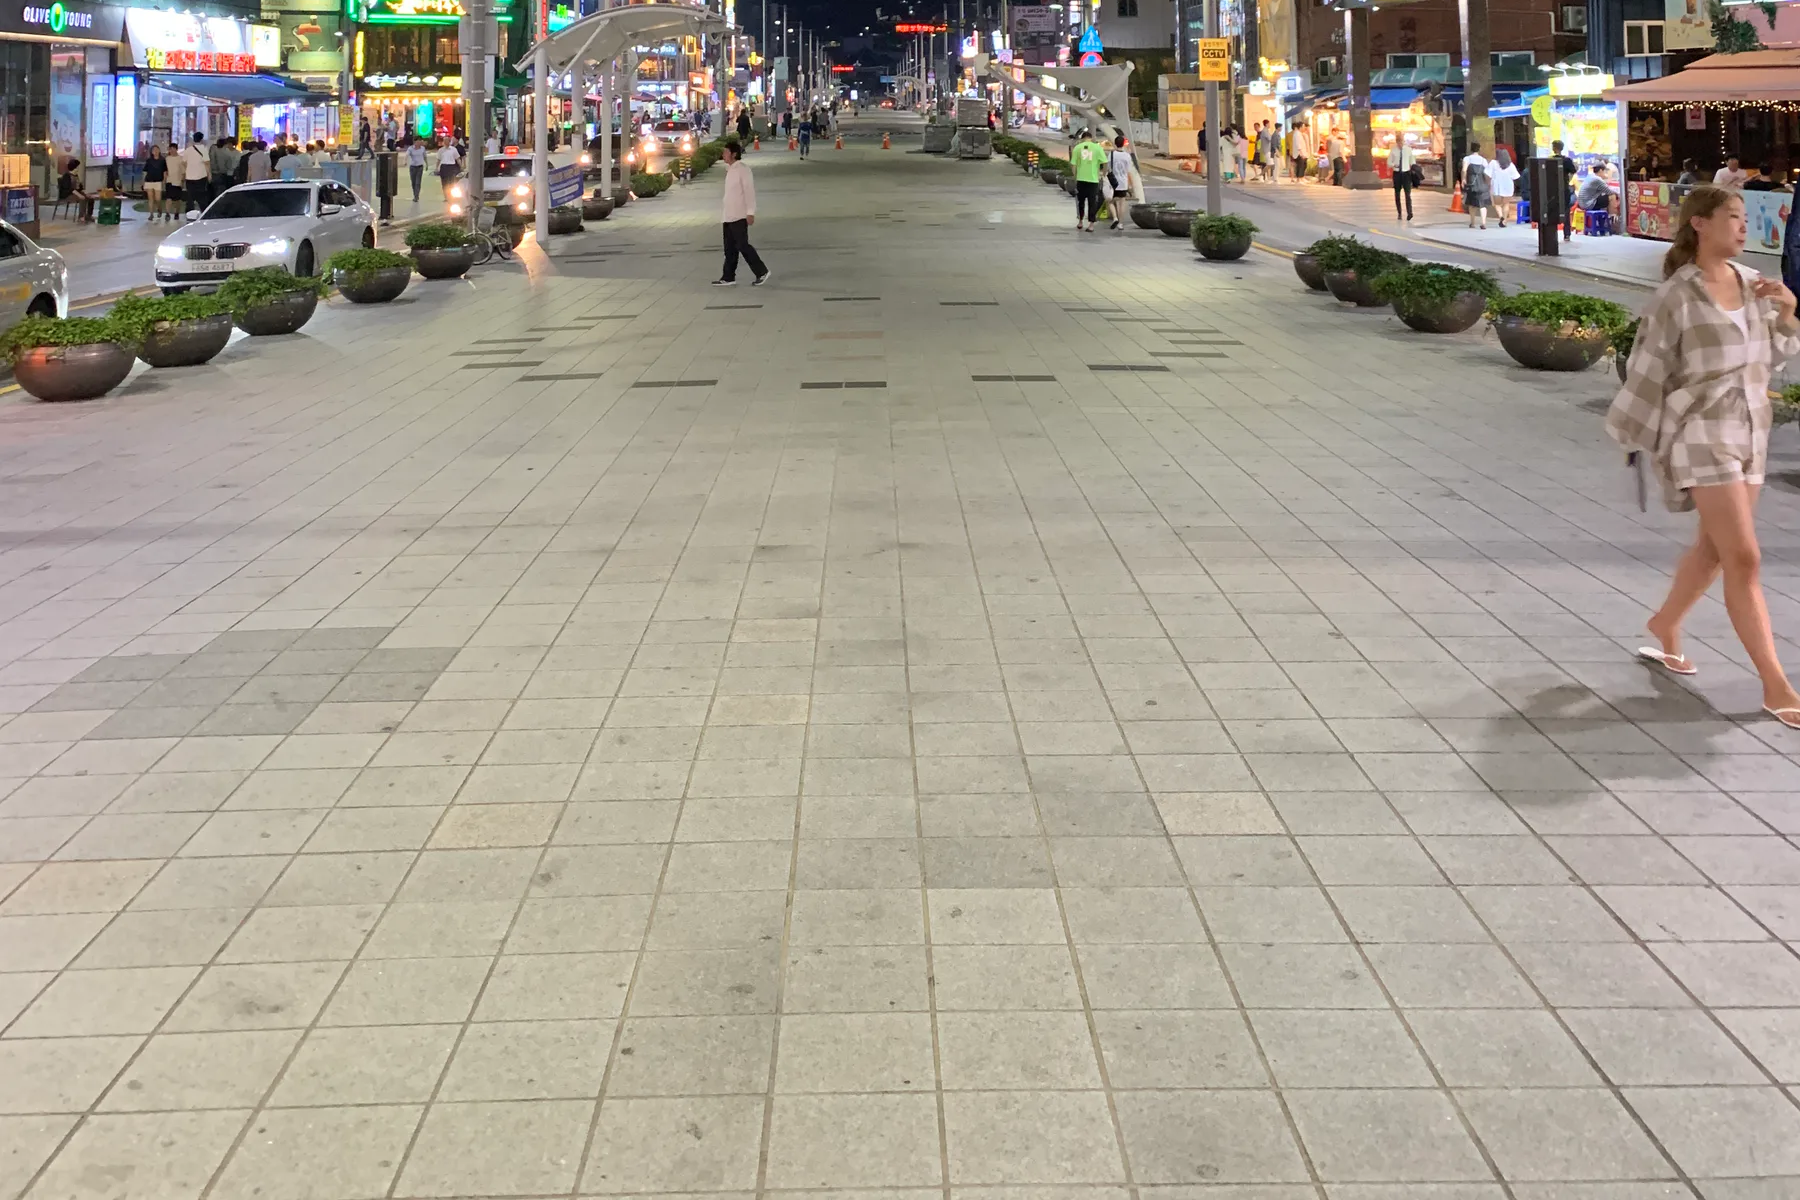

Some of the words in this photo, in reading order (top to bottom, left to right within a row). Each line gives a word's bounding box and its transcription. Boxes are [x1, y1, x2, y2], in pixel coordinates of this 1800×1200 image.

[23, 6, 50, 24] OLIVE
[64, 11, 92, 29] YOUNG
[1203, 50, 1224, 58] CCTV
